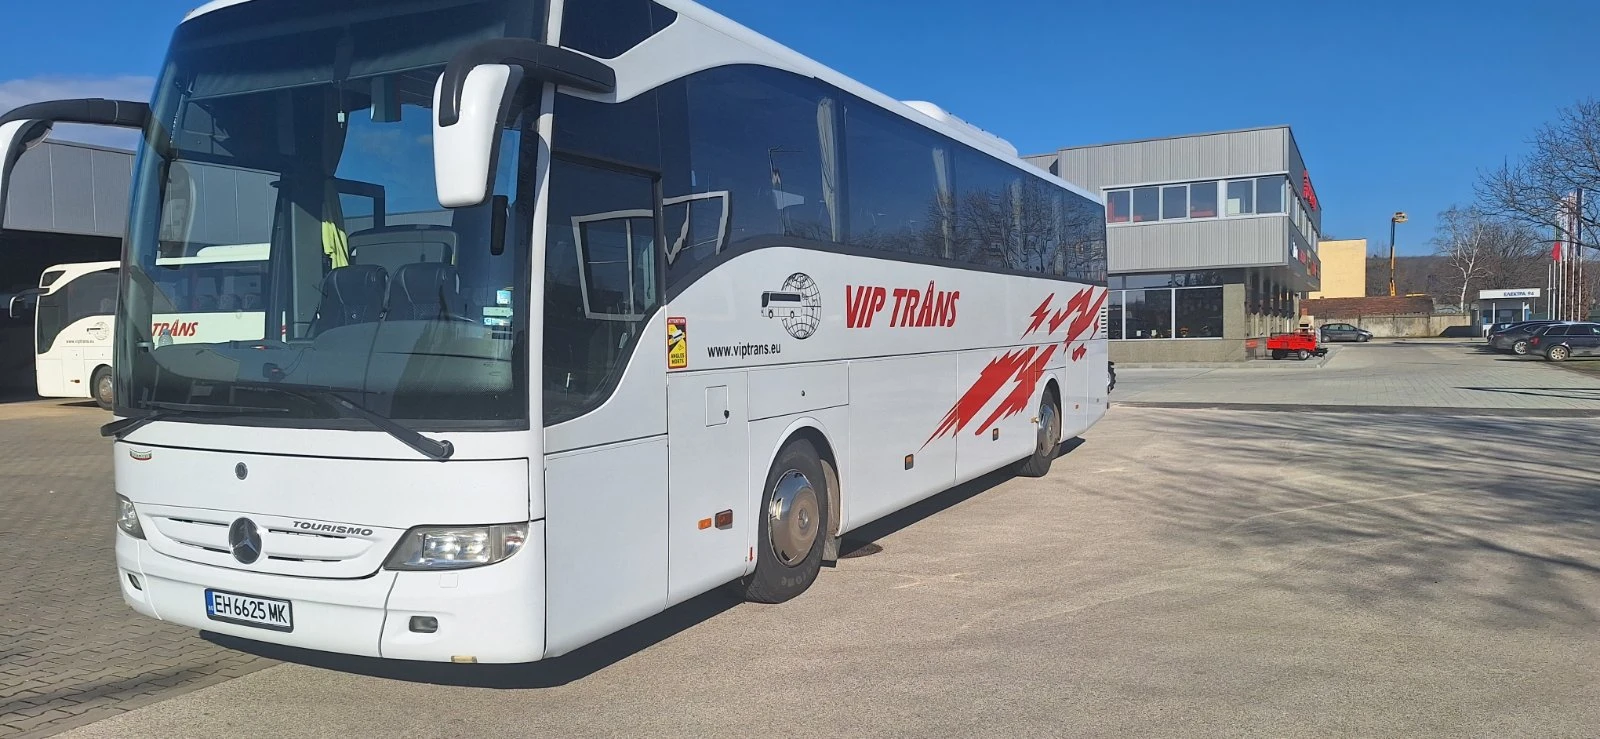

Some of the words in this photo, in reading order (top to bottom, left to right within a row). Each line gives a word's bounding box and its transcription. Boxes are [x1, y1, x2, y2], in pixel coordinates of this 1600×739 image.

[846, 285, 886, 328] VIP
[889, 280, 960, 328] TRANS
[152, 319, 199, 337] TRANS
[707, 341, 781, 360] www.viptrans.eu
[293, 520, 373, 536] TOURISMO
[215, 595, 232, 615] EH
[234, 598, 266, 619] 6625
[268, 603, 287, 623] MK
